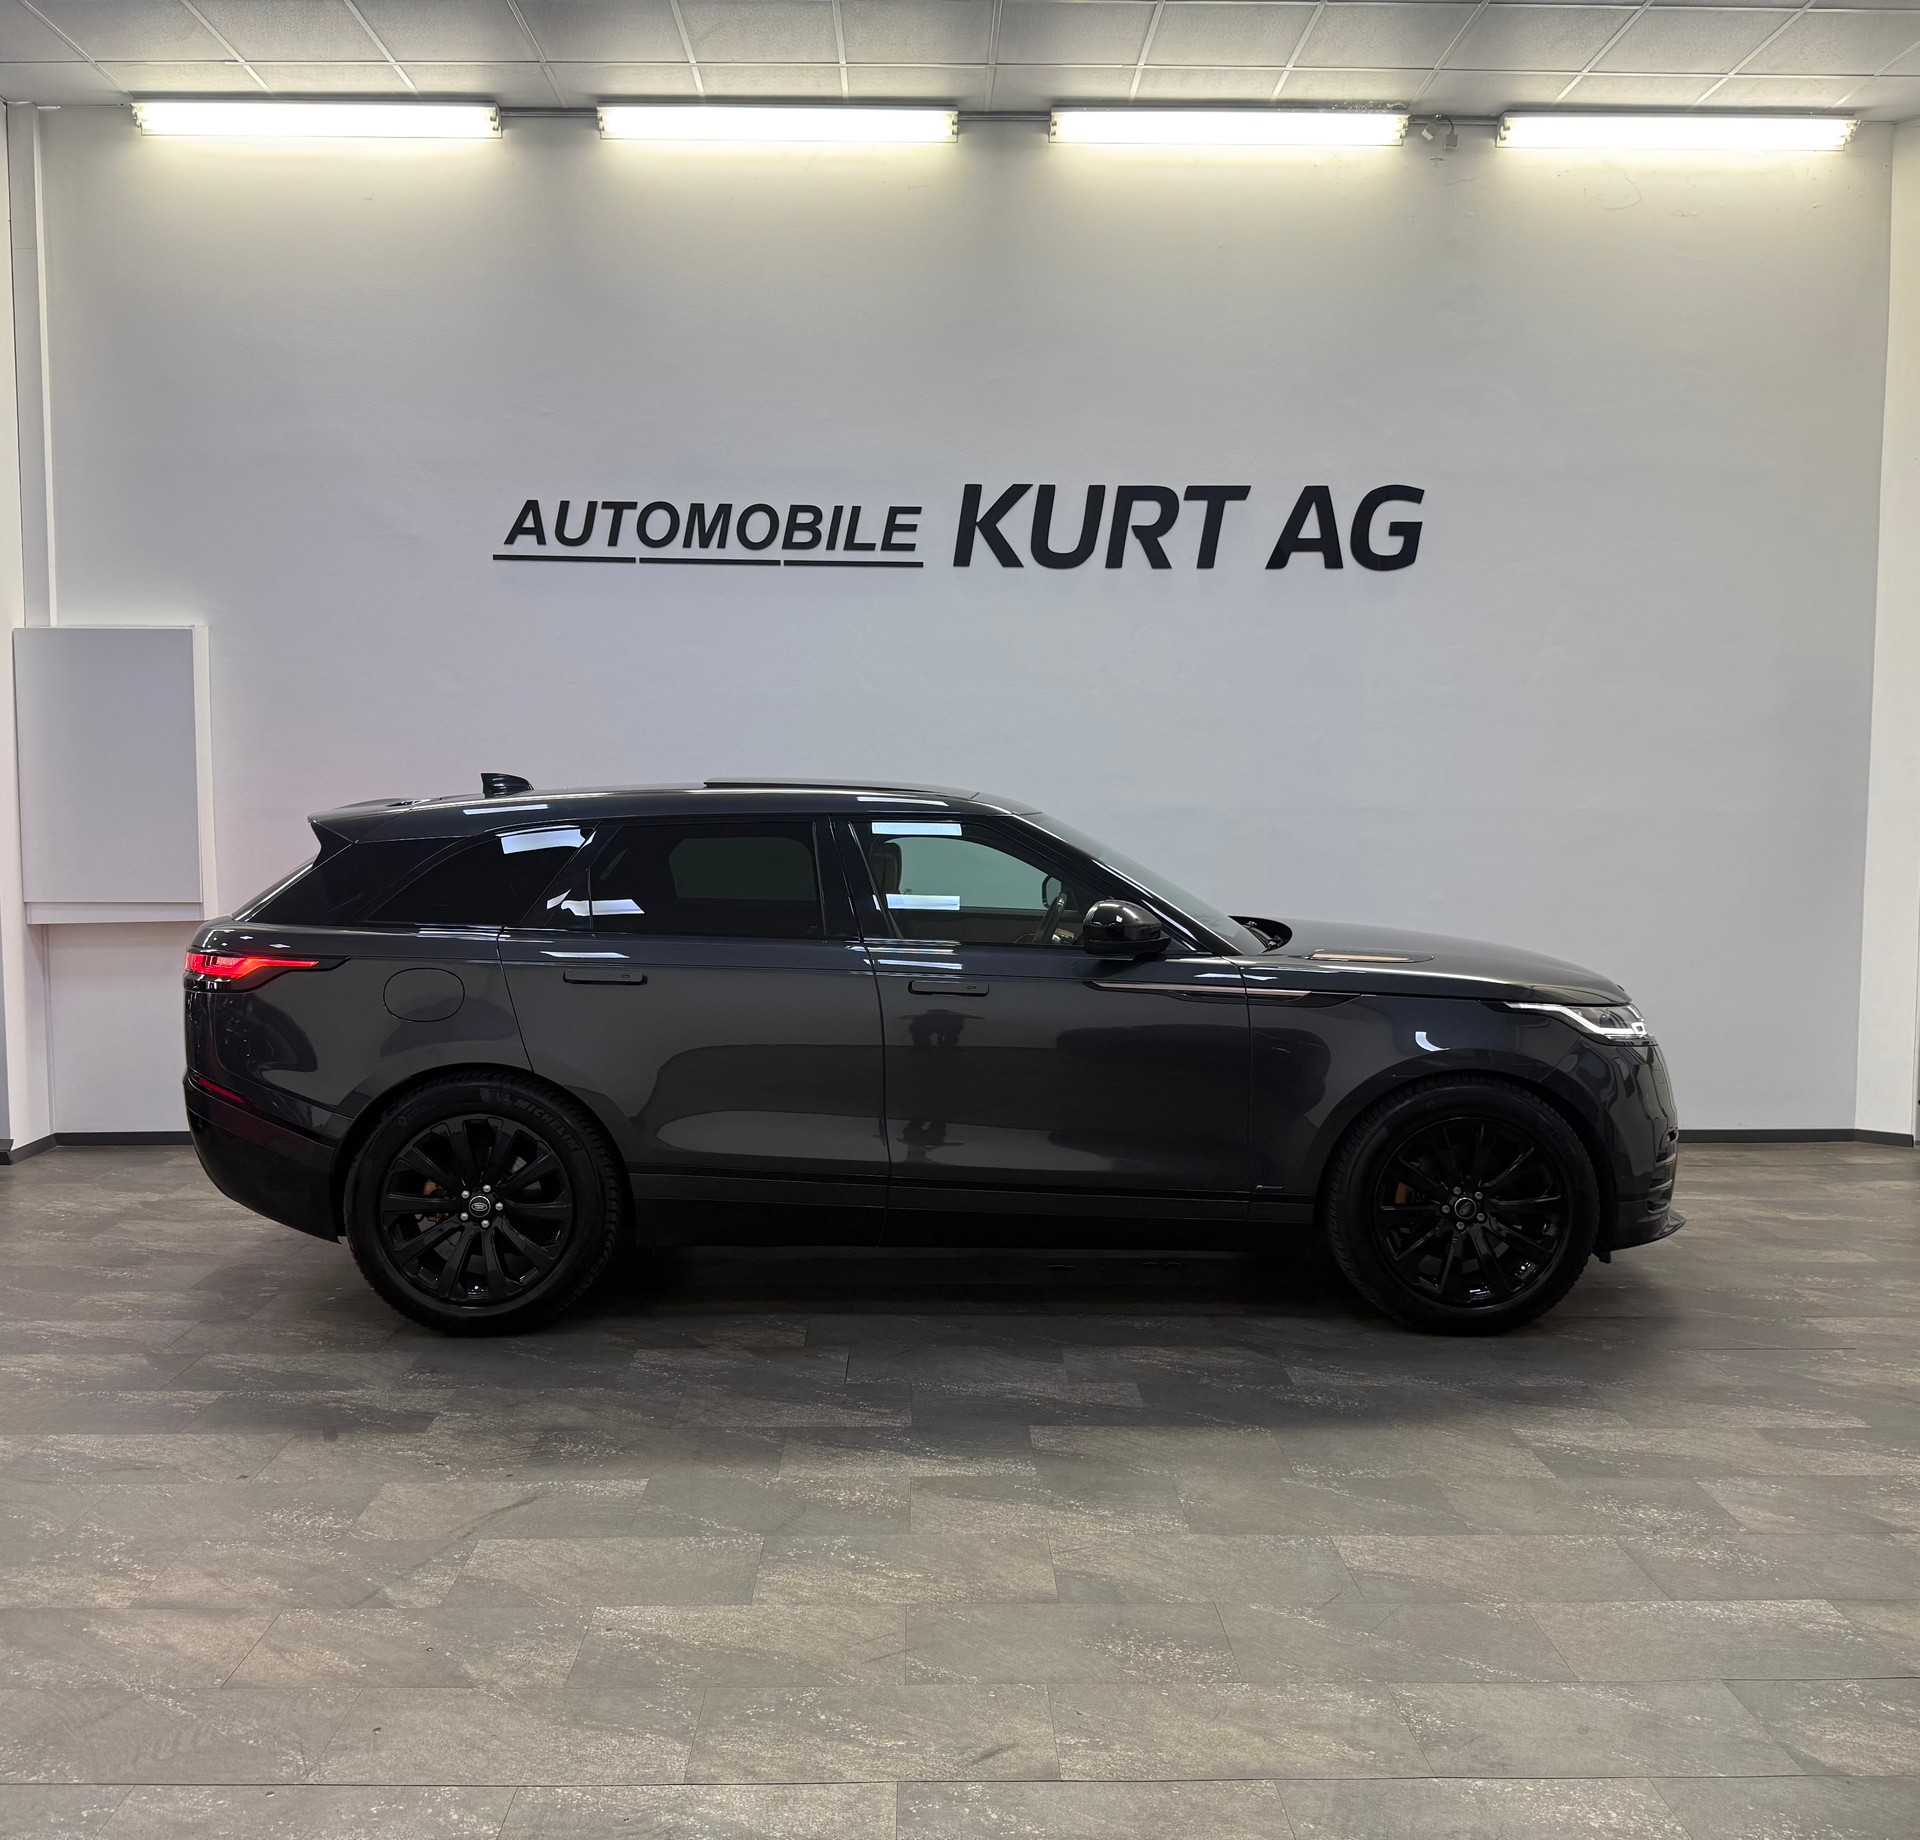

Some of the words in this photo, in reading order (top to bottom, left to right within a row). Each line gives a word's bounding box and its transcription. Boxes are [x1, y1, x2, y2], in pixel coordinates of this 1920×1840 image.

[504, 499, 923, 552] AUTOMOBILE
[953, 484, 1251, 570] KURT
[1265, 485, 1425, 571] AG
[514, 1098, 580, 1151] MICHELIN
